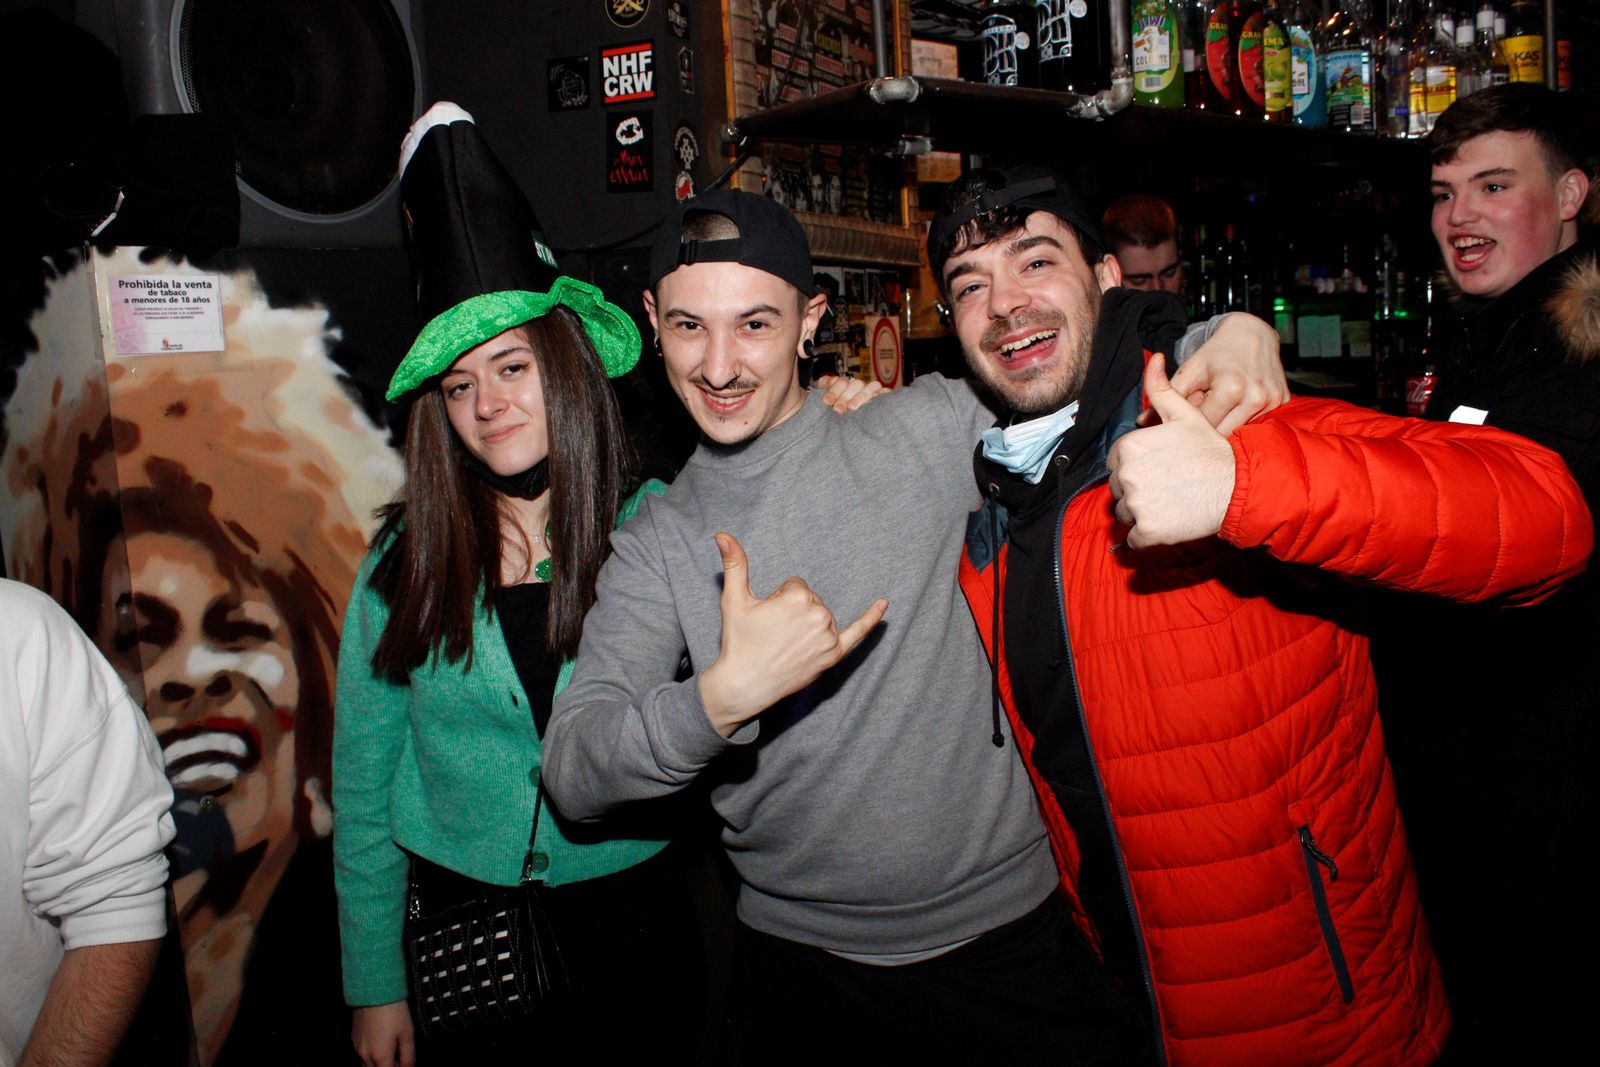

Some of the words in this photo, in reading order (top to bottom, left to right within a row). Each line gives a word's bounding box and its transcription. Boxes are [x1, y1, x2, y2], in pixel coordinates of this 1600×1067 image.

[1263, 37, 1284, 46] IMA
[602, 50, 653, 78] NHF
[604, 71, 653, 97] CRW
[118, 280, 169, 289] Prohibida
[172, 280, 181, 289] la
[185, 280, 212, 289] venta
